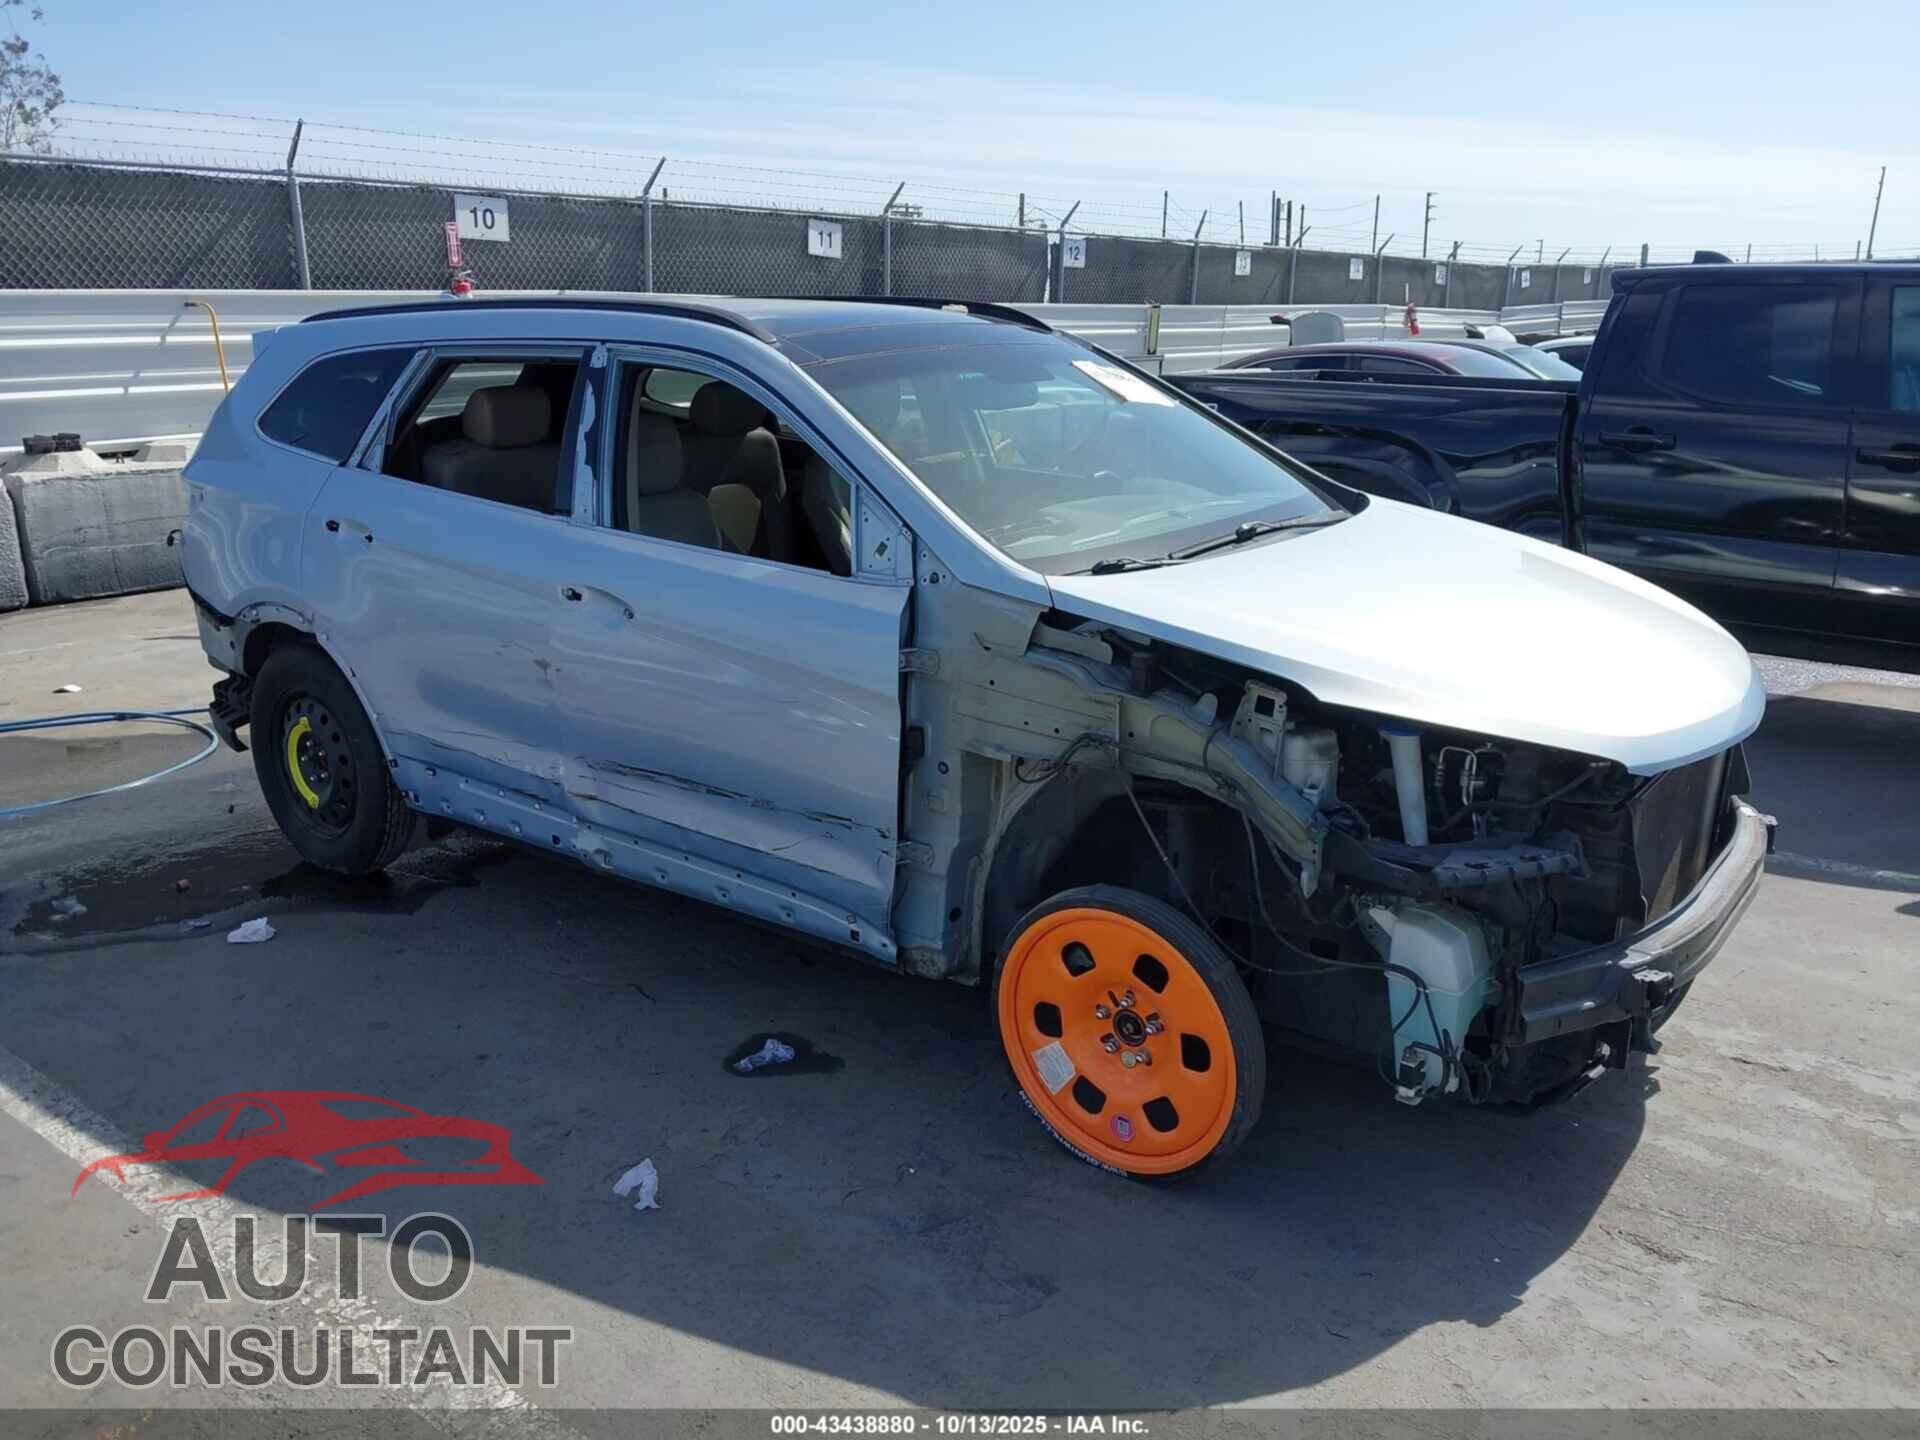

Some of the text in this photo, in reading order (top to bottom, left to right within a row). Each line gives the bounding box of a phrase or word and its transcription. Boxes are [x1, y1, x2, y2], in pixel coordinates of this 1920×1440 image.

[470, 206, 496, 230] 10
[818, 229, 833, 249] 11
[1068, 245, 1081, 261] 12
